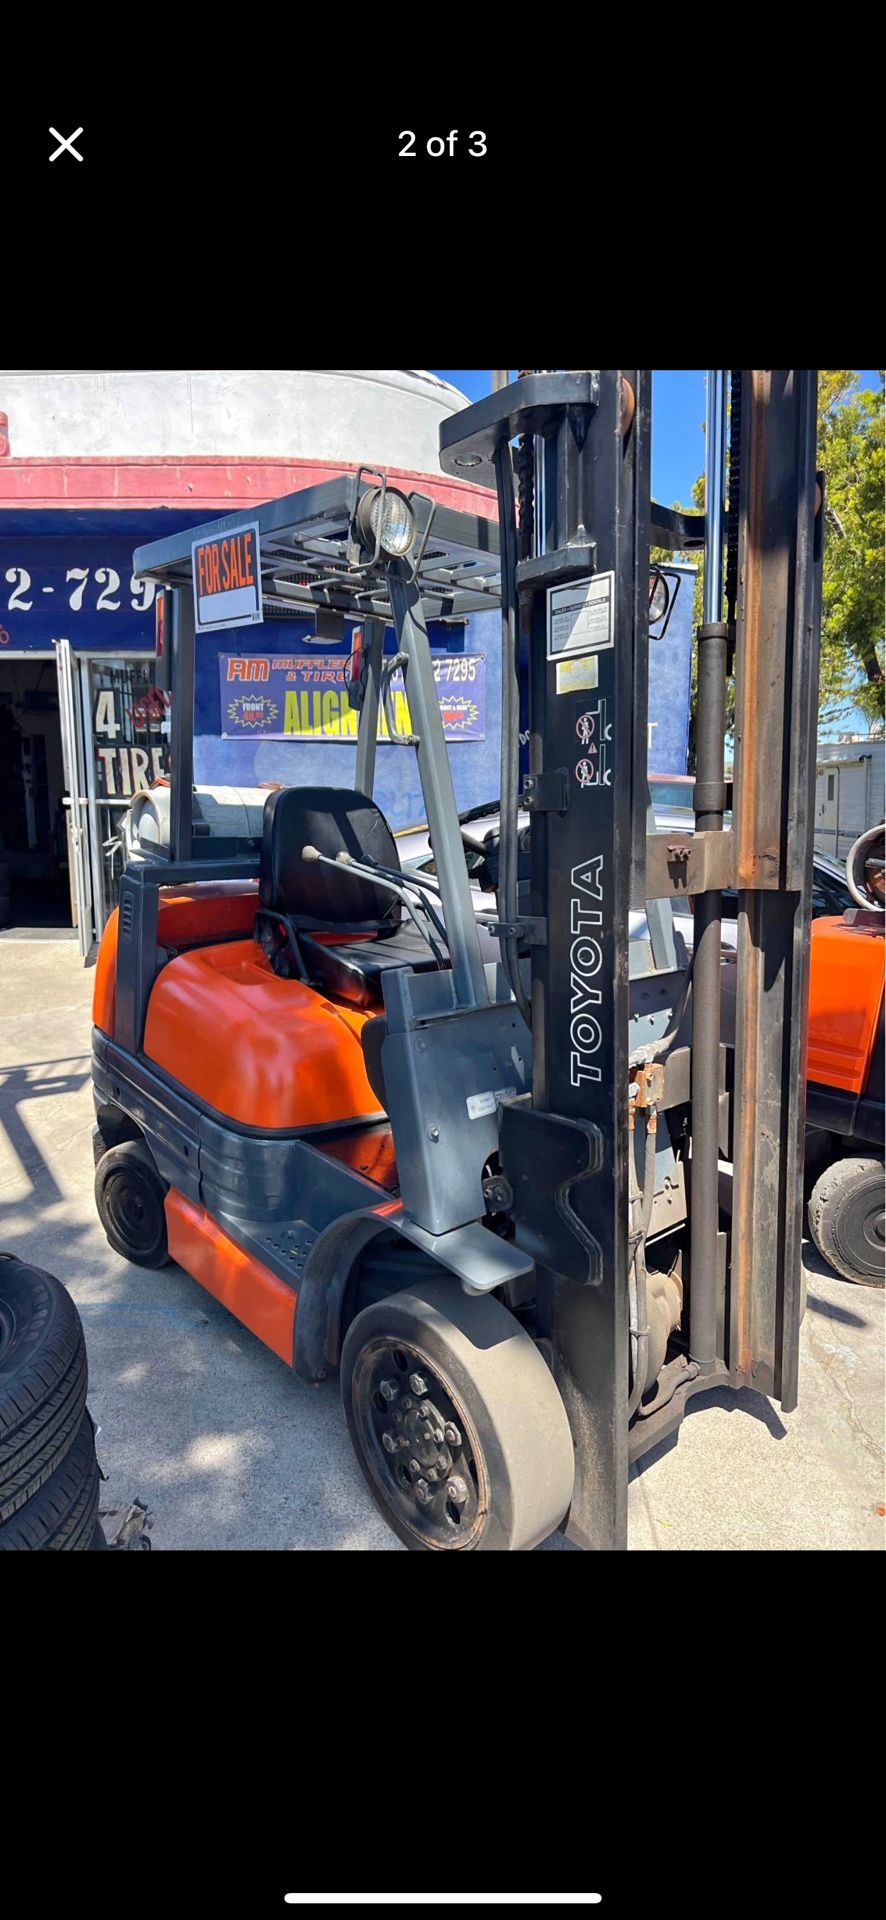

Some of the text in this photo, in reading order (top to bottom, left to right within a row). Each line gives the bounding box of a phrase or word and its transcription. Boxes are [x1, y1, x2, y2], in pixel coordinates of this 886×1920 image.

[197, 532, 254, 596] FOR SALE
[444, 657, 476, 682] 7295
[96, 690, 121, 739] 4
[242, 702, 264, 711] FRONT
[570, 854, 604, 1088] TOYOTA
